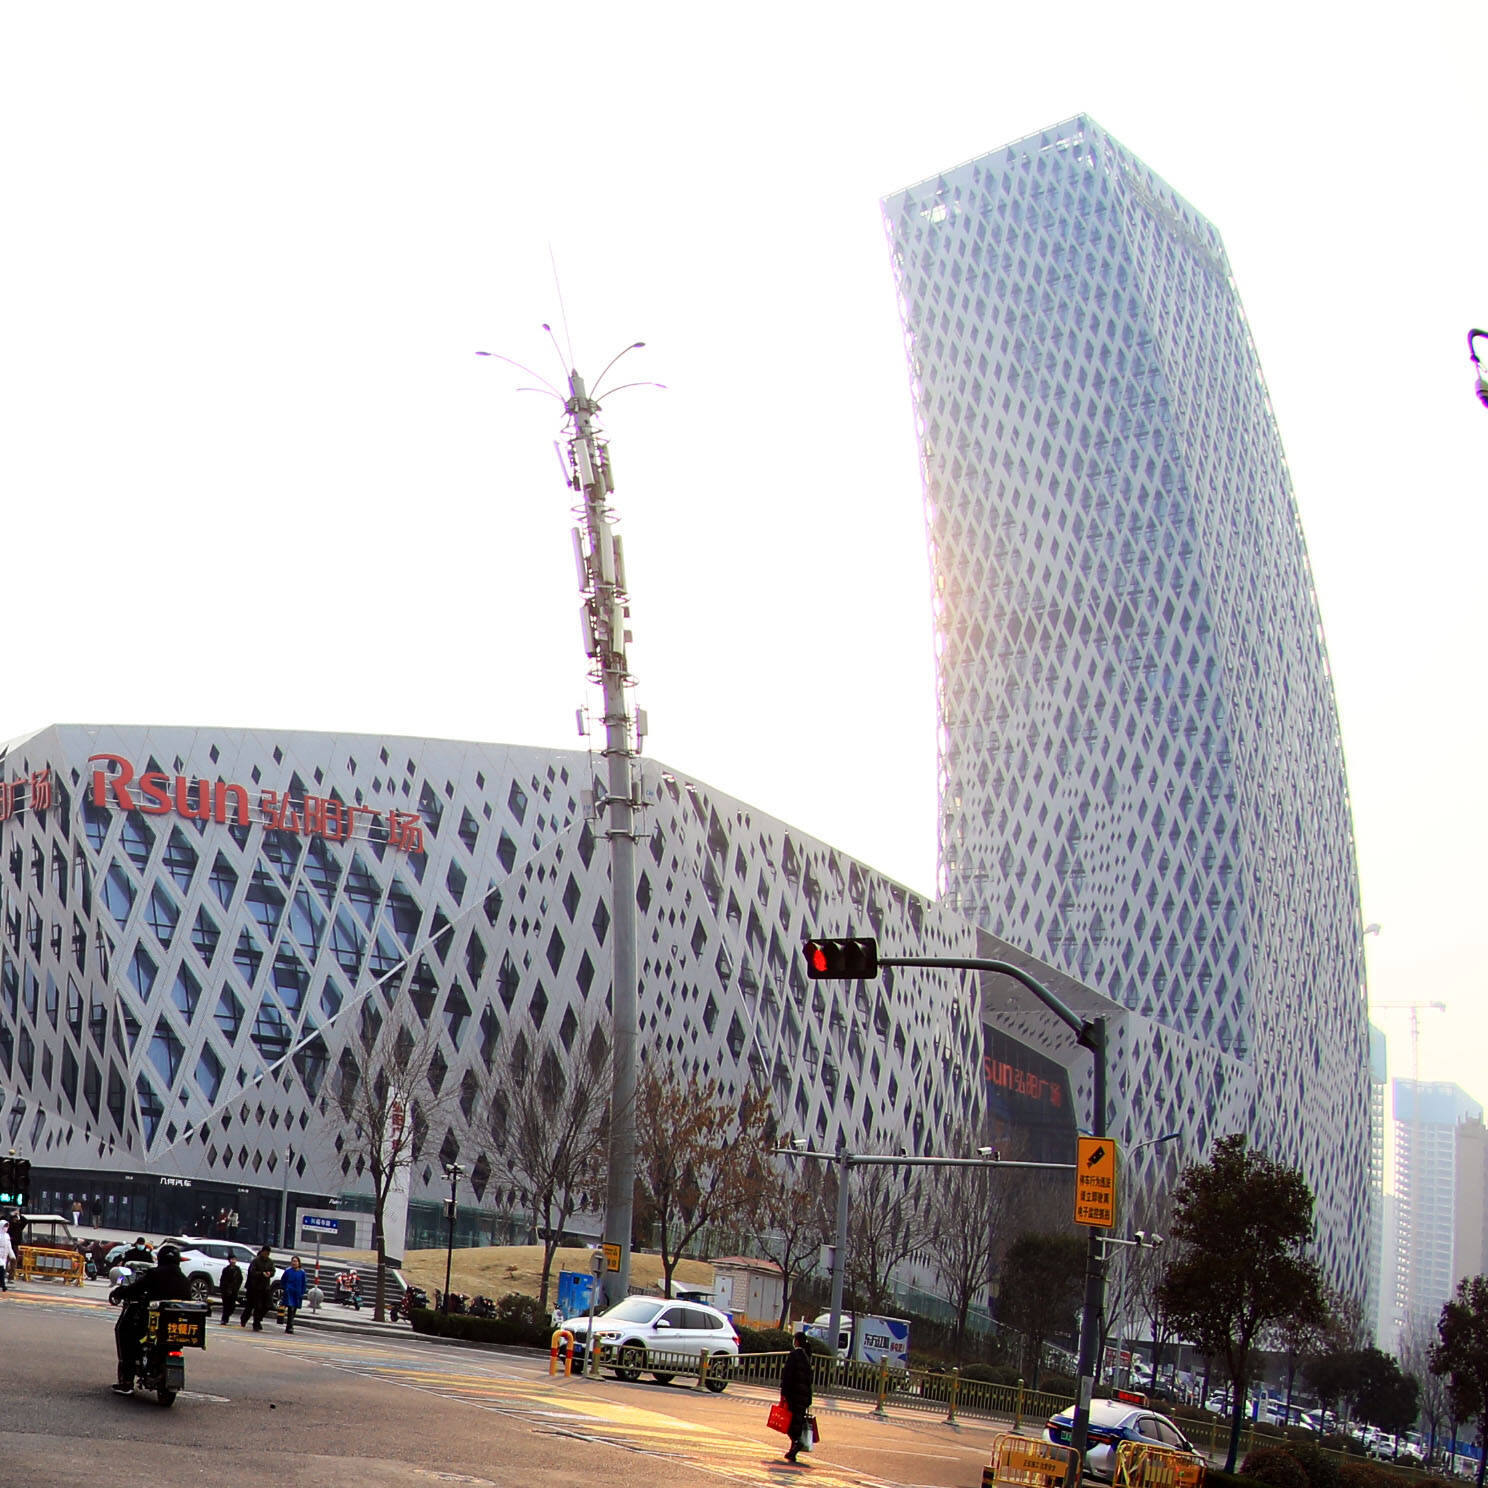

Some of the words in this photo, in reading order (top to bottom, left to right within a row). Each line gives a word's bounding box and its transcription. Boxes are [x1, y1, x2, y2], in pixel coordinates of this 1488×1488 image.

[87, 753, 249, 827] Rsun
[261, 788, 425, 854] 弘阳广场
